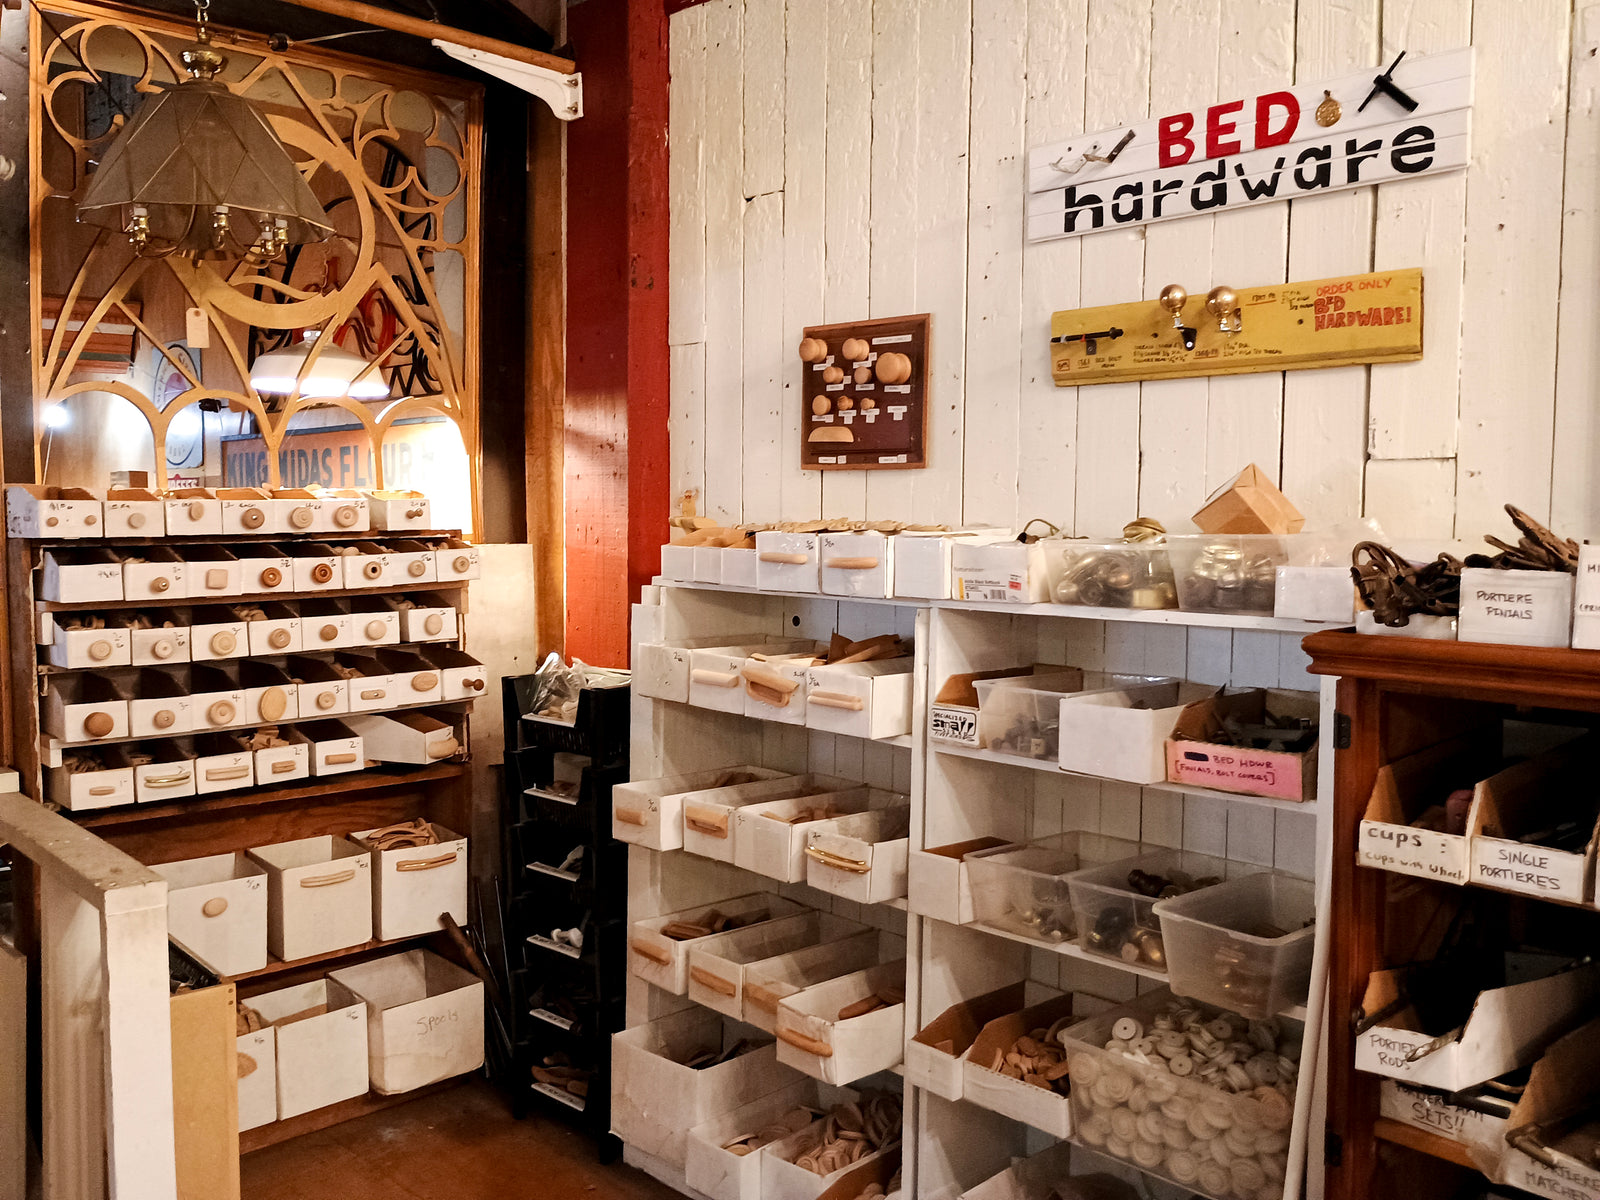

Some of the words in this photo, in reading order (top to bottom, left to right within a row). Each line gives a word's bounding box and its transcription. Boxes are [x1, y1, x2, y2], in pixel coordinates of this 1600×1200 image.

[1158, 90, 1301, 169] BED
[1062, 124, 1436, 233] hardware
[1316, 282, 1354, 297] ORDER
[1358, 277, 1393, 290] ONLY
[1313, 295, 1346, 315] BED
[1314, 306, 1412, 332] HARDWARE!
[226, 450, 269, 489] KING
[278, 447, 334, 489] MIDAS
[1476, 589, 1534, 605] PORTIERE
[1213, 754, 1235, 765] BED
[1498, 849, 1549, 869] SINGLE
[1479, 864, 1561, 891] PORTIERES
